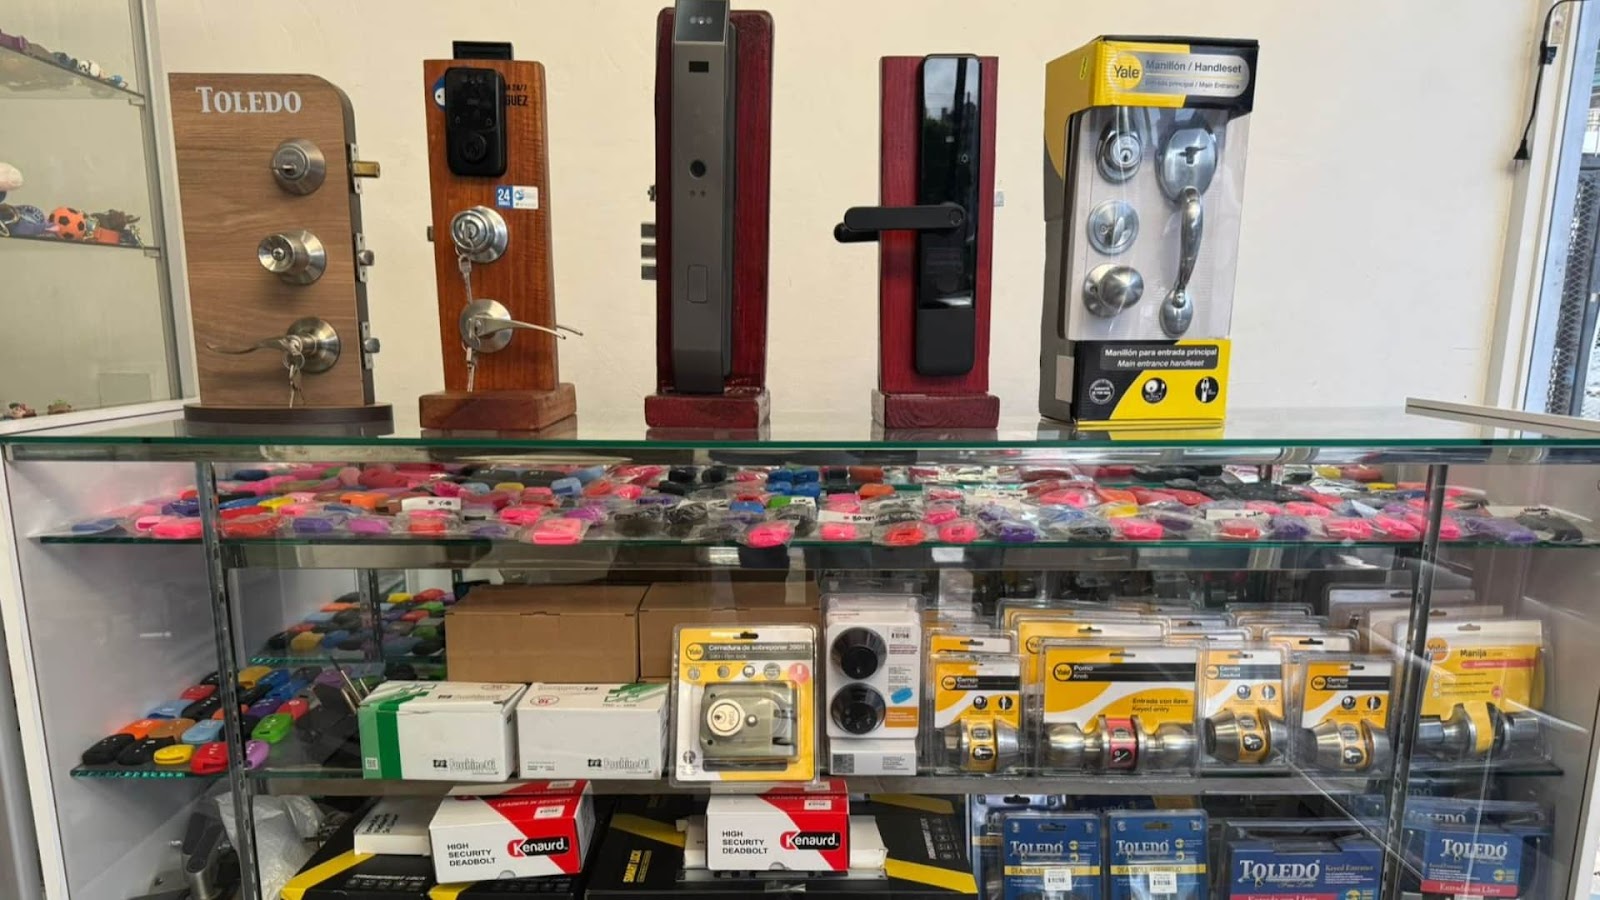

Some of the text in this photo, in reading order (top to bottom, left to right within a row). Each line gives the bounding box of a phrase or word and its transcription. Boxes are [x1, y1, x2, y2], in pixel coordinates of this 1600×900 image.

[1113, 65, 1140, 79] Yale
[1146, 59, 1186, 71] Manillón
[1194, 61, 1242, 73] Handleset
[195, 86, 302, 114] TOLEDO
[497, 188, 511, 201] 24
[1104, 348, 1217, 359] Manillón para entrada principal
[1117, 359, 1136, 367] Main
[1460, 649, 1487, 659] Manija
[721, 830, 744, 838] HIGH
[786, 832, 839, 849] Kenaurd
[446, 842, 470, 852] HIGH
[512, 837, 566, 857] Kenaurd
[721, 838, 766, 847] SECURITY
[1009, 840, 1064, 856] TOLEDO
[1115, 839, 1169, 856] TOLEDO
[1441, 838, 1509, 859] TOLEDO
[447, 849, 492, 860] SECURITY
[721, 847, 769, 855] DEADBOLT
[449, 858, 497, 868] DEADBOLT
[1239, 859, 1321, 881] TOLEDO
